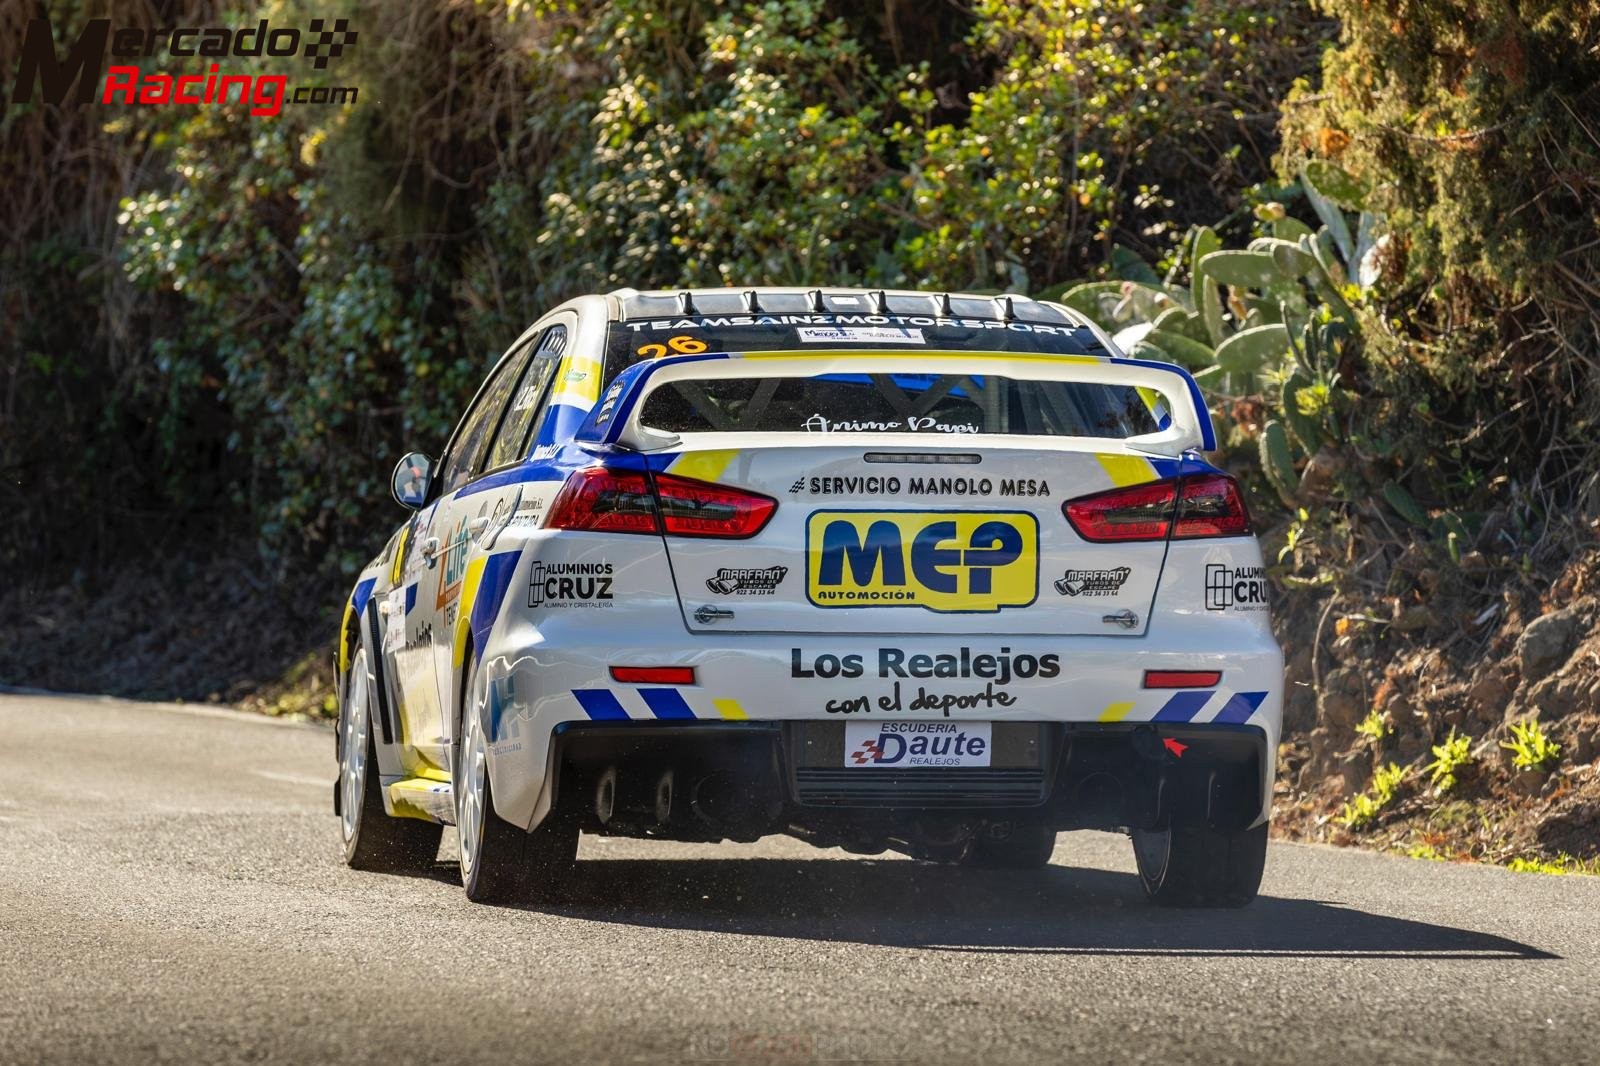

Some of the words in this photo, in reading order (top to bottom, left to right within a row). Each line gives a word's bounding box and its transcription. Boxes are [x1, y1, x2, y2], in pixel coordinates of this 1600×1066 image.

[810, 476, 901, 495] SERVICIO
[909, 477, 993, 496] MANOLO
[999, 479, 1051, 497] MESA
[818, 520, 1024, 594] MEP
[546, 563, 613, 575] ALUMINIOS
[545, 577, 613, 600] CRUZ
[818, 590, 915, 600] AUTOMOCIÓN
[791, 648, 864, 679] Los
[878, 647, 1061, 685] Realejos
[825, 695, 871, 714] con
[878, 681, 902, 712] el
[909, 682, 1018, 717] deporte
[881, 722, 958, 734] ESCUDERIA
[873, 731, 986, 764] Daute
[909, 758, 961, 766] REALEJOS
